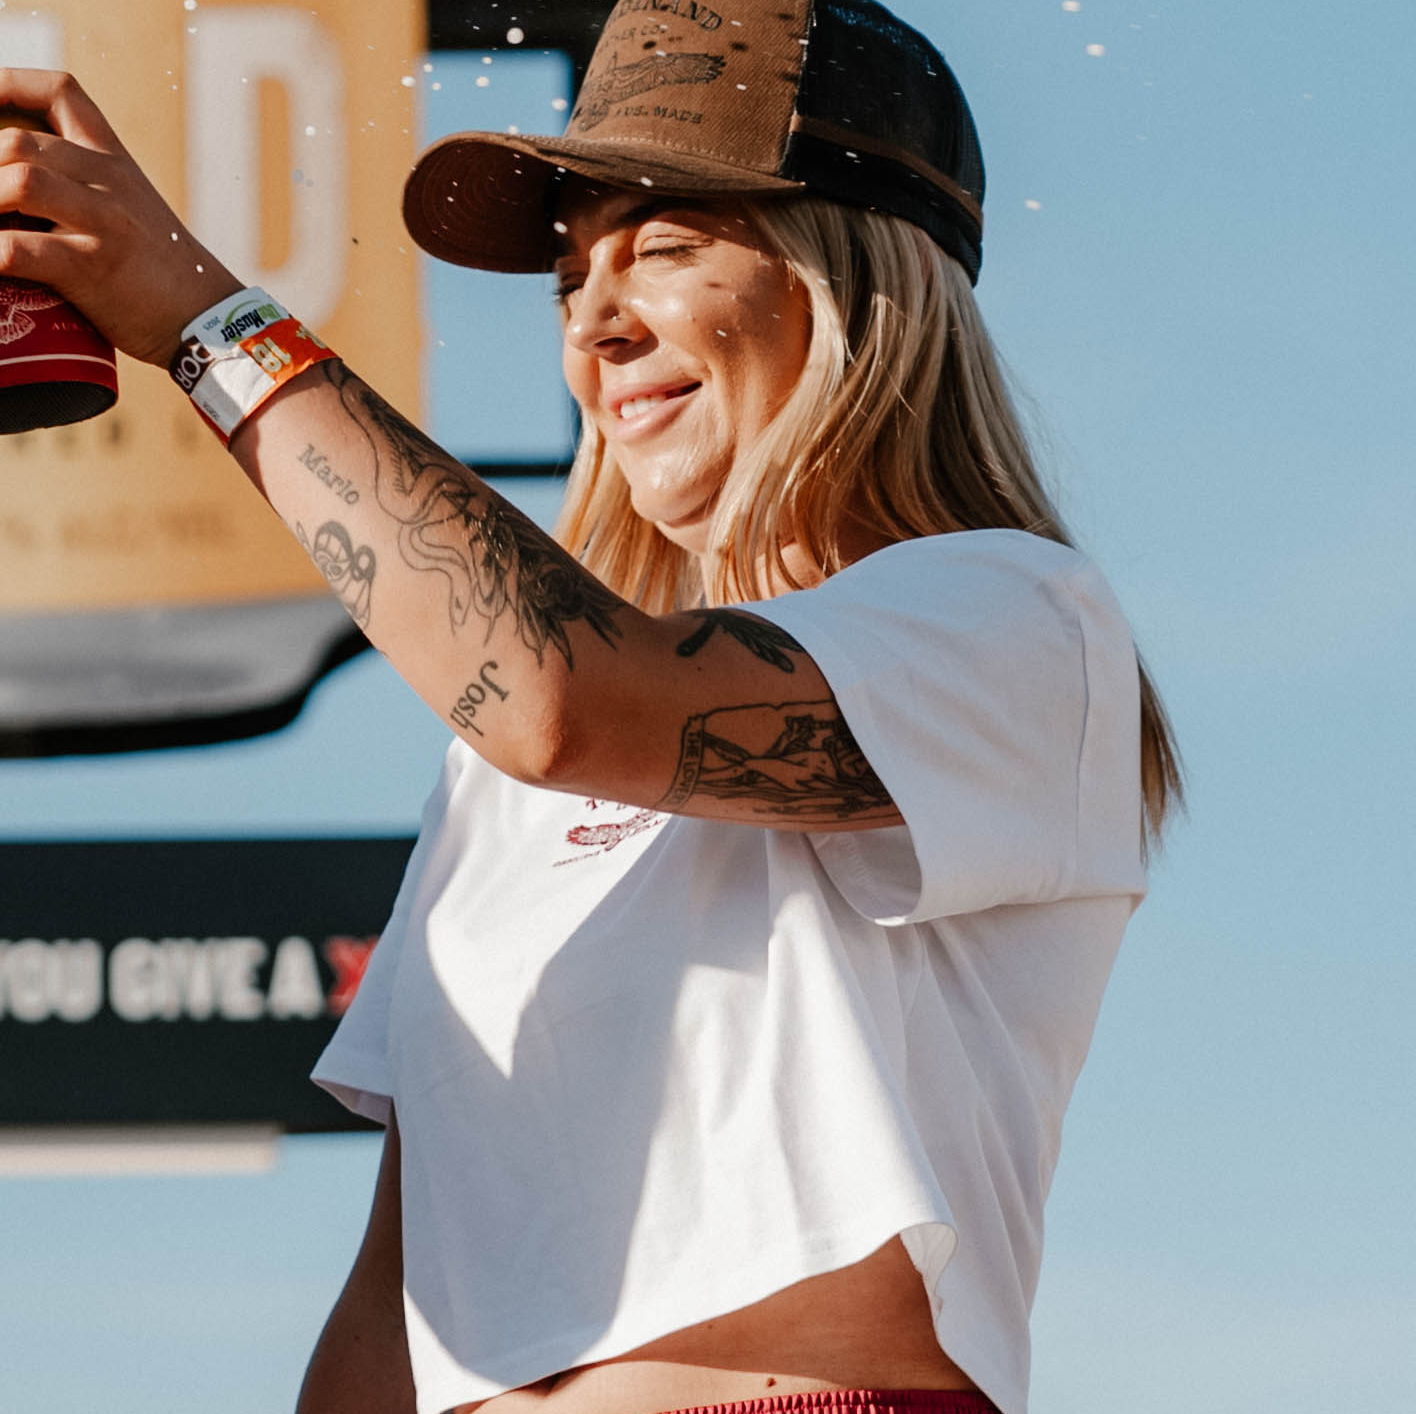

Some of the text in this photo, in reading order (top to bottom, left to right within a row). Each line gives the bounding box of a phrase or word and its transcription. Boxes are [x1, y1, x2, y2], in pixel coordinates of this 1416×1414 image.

[296, 443, 361, 506] Marlo
[450, 659, 511, 737] Josh
[108, 936, 269, 1022] GIVE
[267, 934, 327, 1021] A
